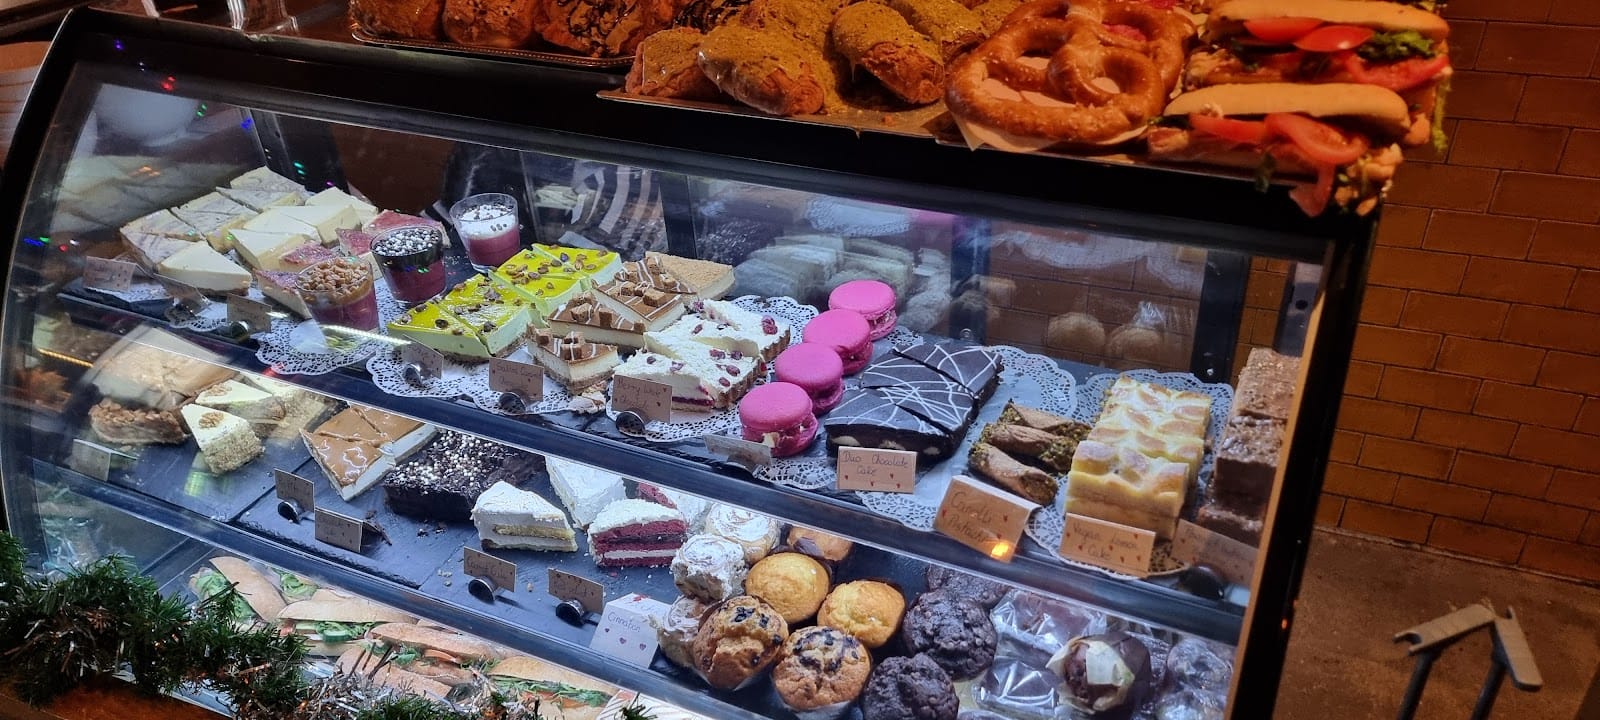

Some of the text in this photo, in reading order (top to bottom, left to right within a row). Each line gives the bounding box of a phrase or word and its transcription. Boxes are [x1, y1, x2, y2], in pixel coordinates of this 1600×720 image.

[841, 451, 909, 469] Duo Chocolate
[857, 465, 877, 476] Cake
[1073, 521, 1100, 545] Vegan
[1088, 543, 1112, 561] Cake
